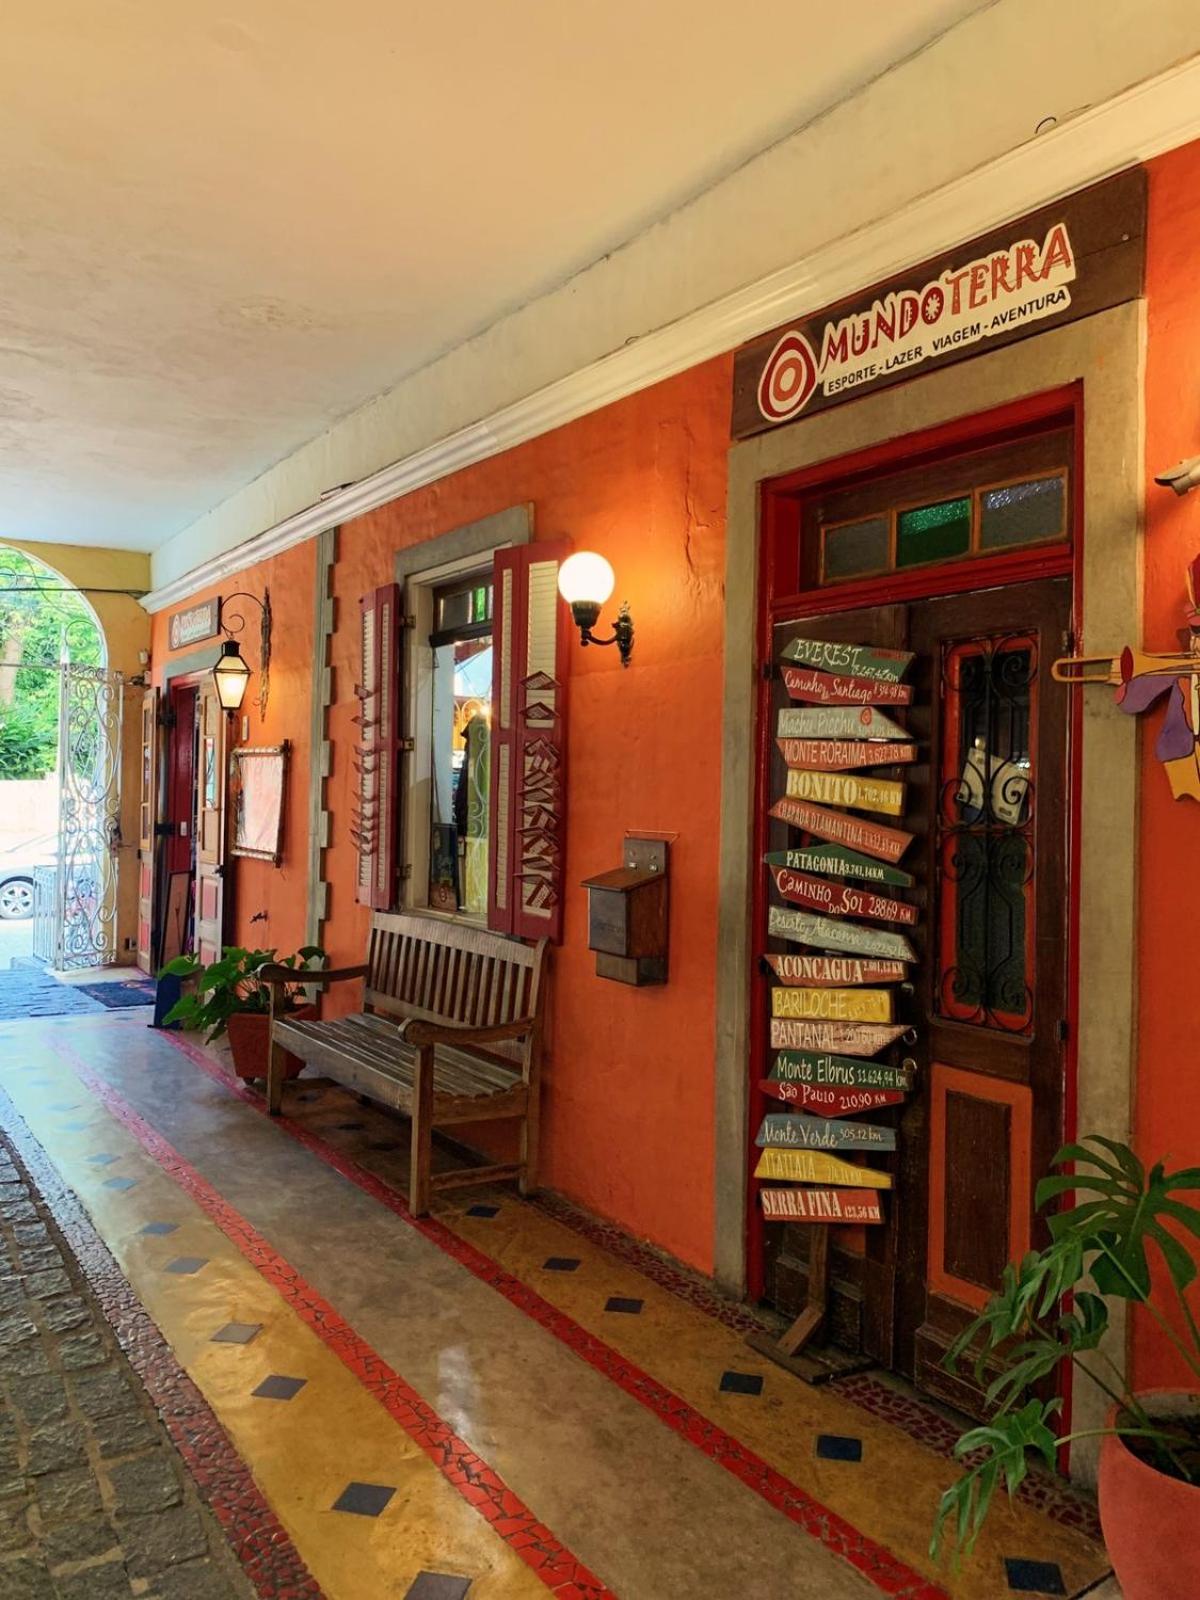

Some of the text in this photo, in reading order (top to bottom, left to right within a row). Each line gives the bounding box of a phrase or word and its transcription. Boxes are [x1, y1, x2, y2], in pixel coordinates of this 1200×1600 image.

[820, 225, 1072, 374] MUNDOTERRA
[828, 366, 877, 393] ESPORTE
[885, 345, 923, 371] LAZER
[931, 322, 981, 352] VIAGEM
[990, 289, 1067, 330] AVENTURA
[794, 639, 863, 668] EVEREST
[784, 741, 818, 763] MONTE
[821, 741, 867, 765] RORAIMA
[788, 771, 858, 805] BONITO
[778, 802, 810, 827] CHAPADA
[811, 811, 863, 844] DIAMANTINA
[786, 851, 846, 876] PATAGONIA
[776, 955, 864, 983] ACONCAGUA
[774, 991, 848, 1018] BARILOCHE
[772, 1021, 839, 1049] PANTANAL
[777, 1056, 812, 1080] Monte
[817, 1056, 855, 1084] Elbrus
[764, 1119, 799, 1144] Monte
[800, 1121, 838, 1148] Verde
[761, 1190, 807, 1217] SERRA
[807, 1190, 843, 1217] FINA
